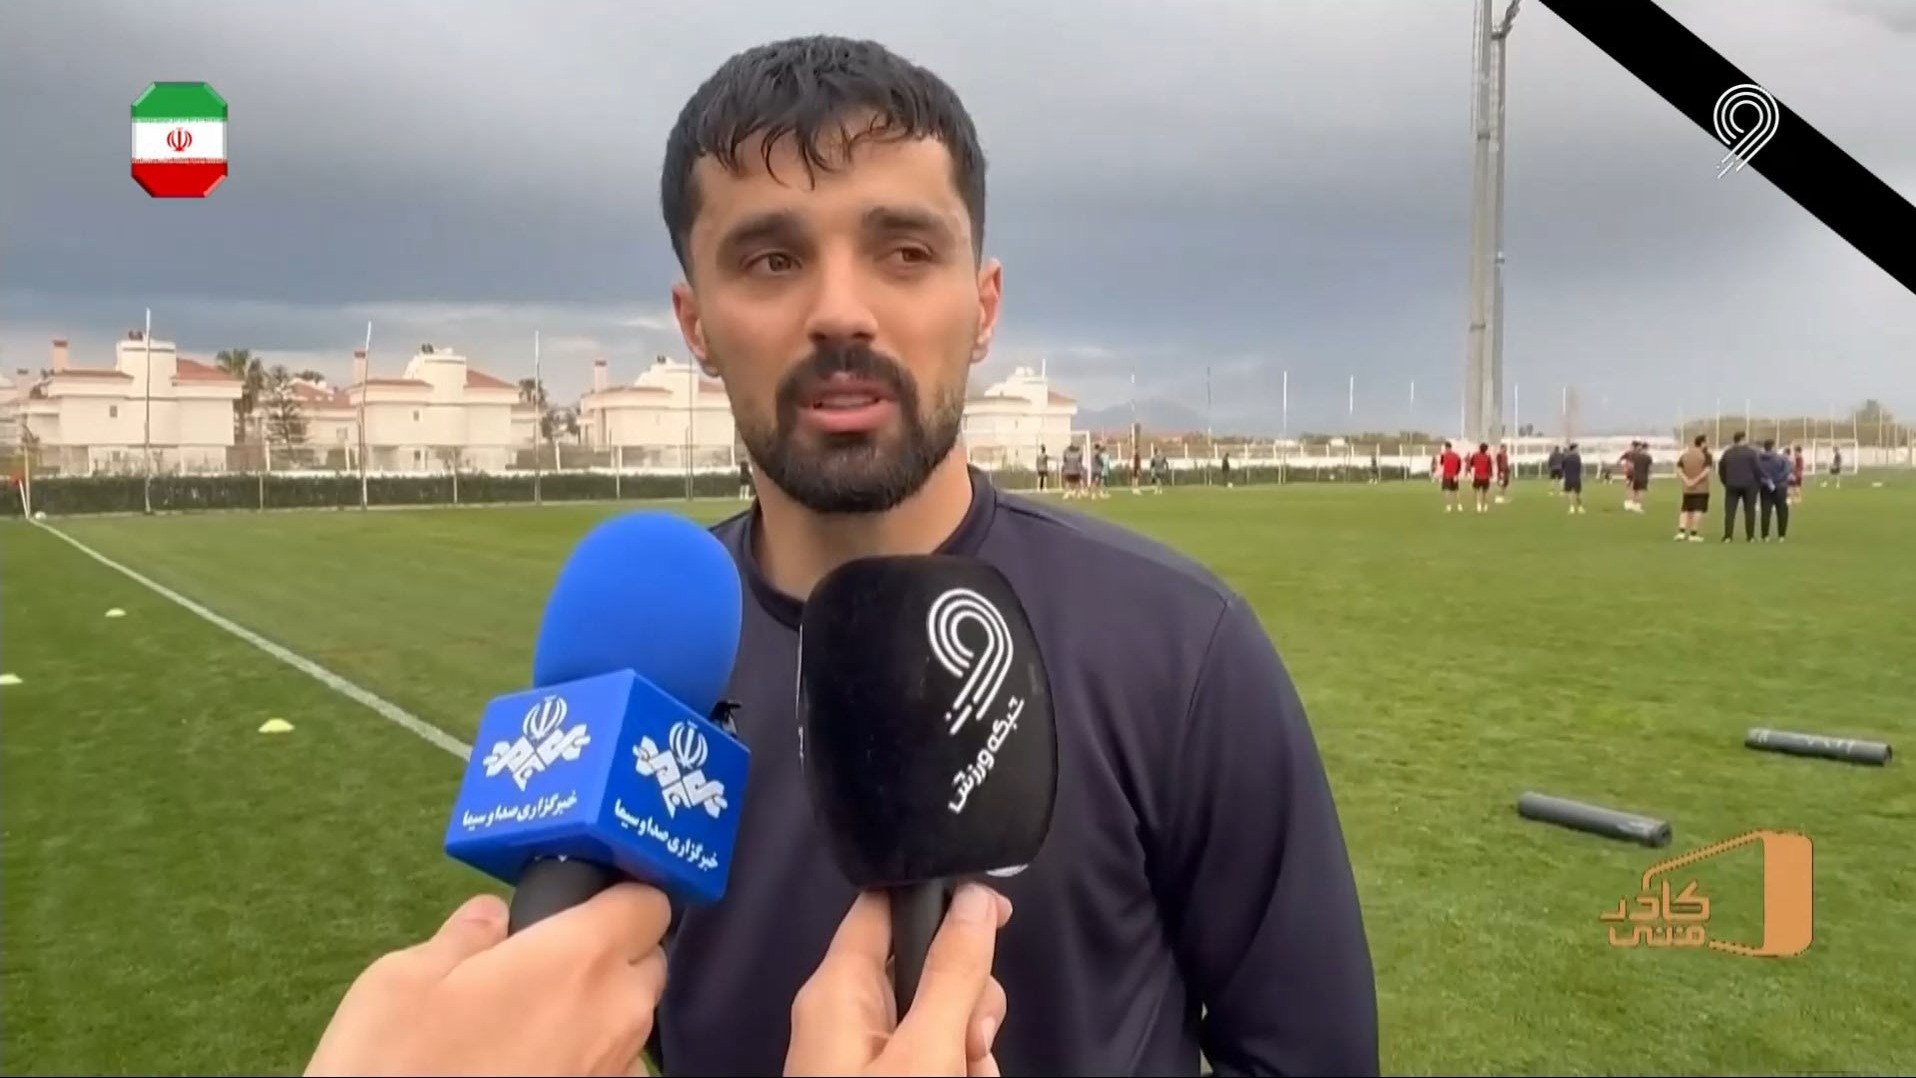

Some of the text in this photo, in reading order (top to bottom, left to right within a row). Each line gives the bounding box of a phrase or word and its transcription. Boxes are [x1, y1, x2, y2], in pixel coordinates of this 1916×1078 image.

[948, 748, 994, 814] ورزش
[517, 790, 577, 822] خبرگزاری
[667, 837, 718, 871] خبرگزاری
